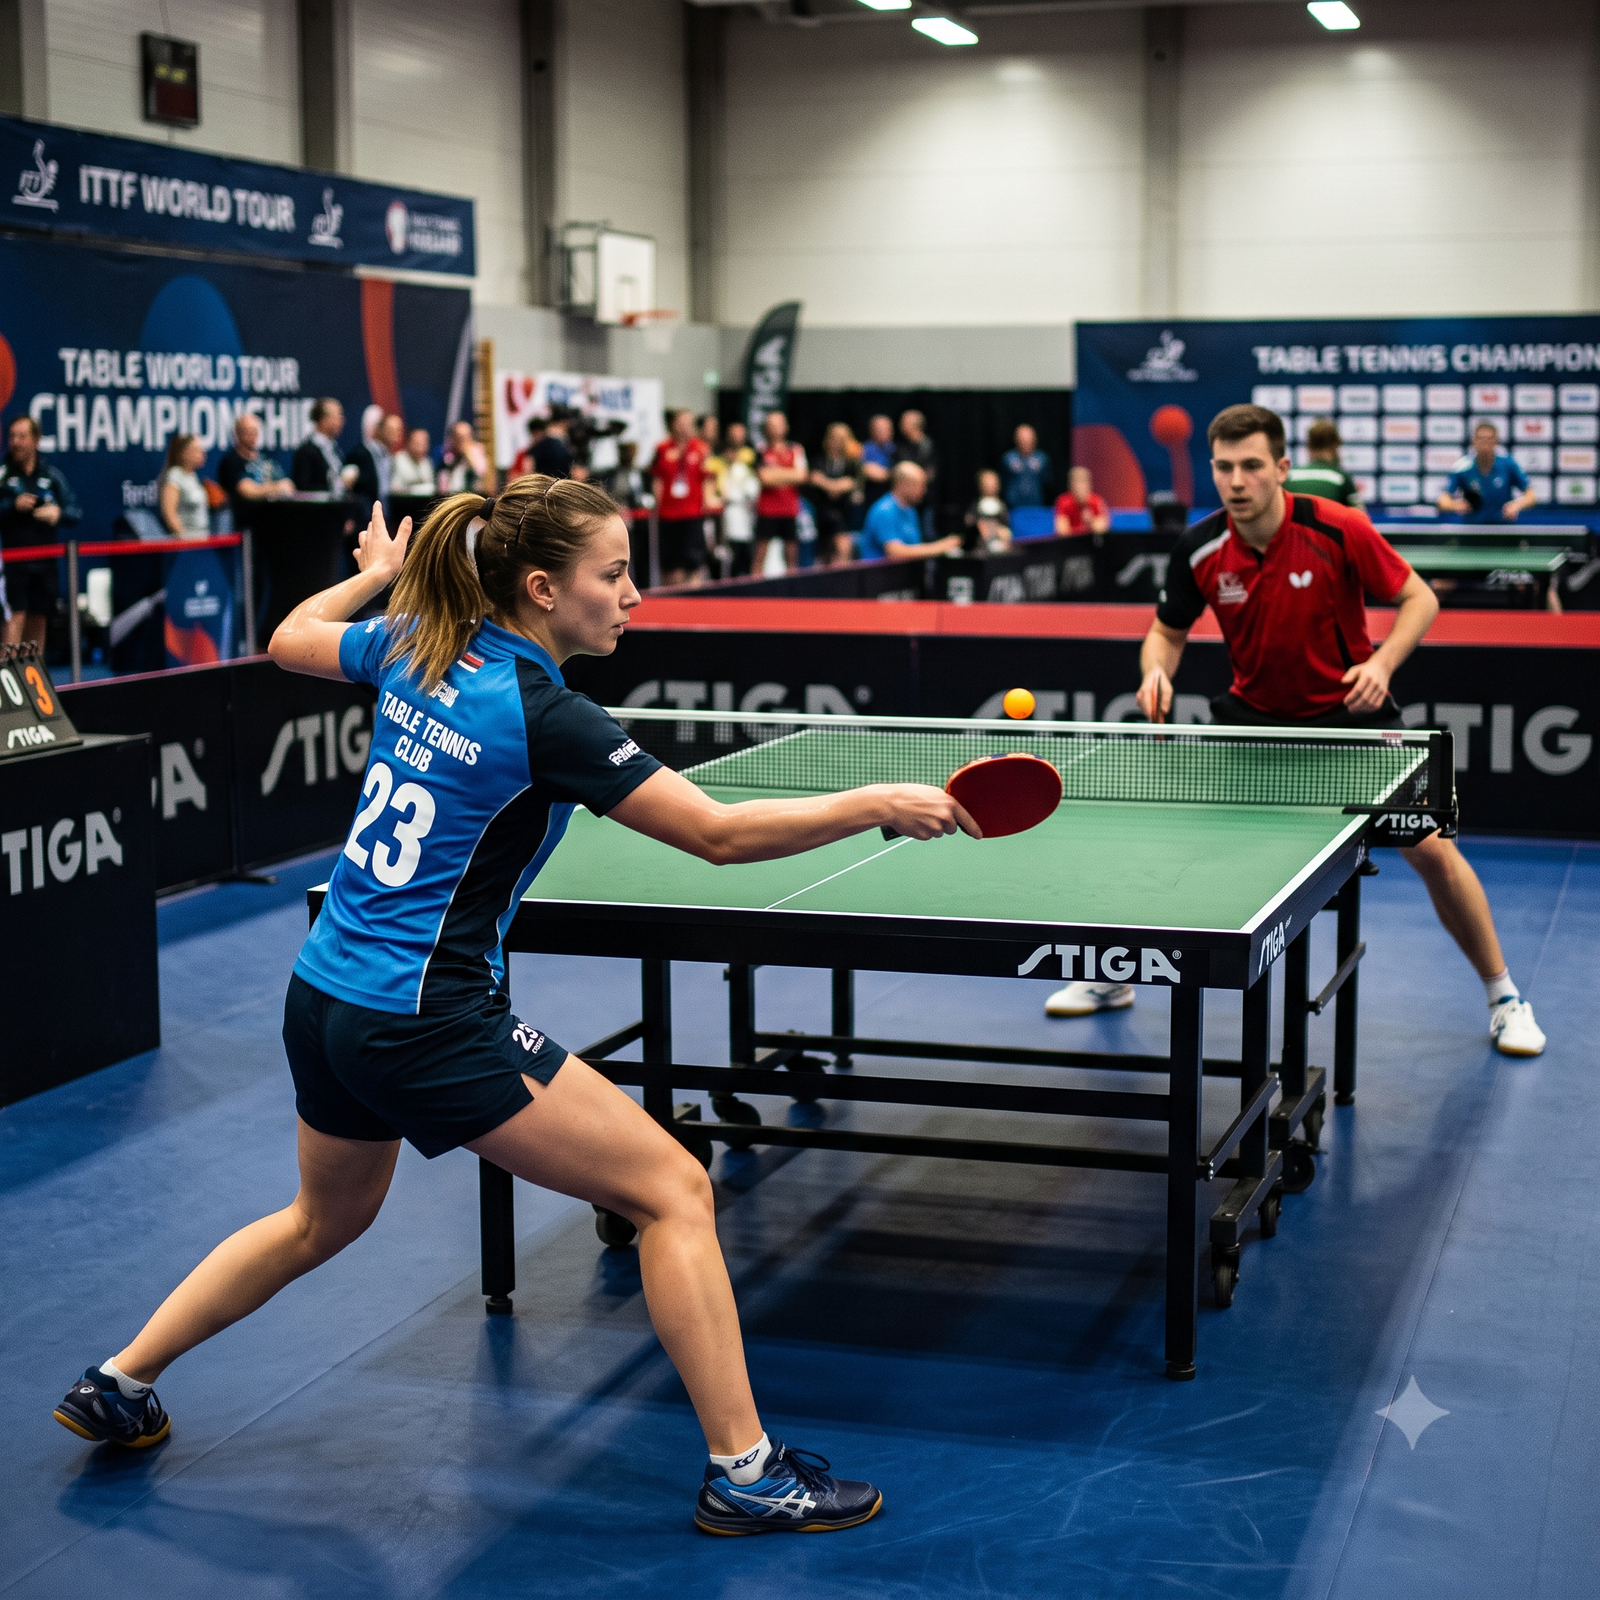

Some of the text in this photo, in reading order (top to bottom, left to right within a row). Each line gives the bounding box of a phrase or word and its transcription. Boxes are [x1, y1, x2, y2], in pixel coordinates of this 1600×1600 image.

[79, 165, 138, 209] ITTF
[140, 174, 232, 223] WORLD
[233, 188, 296, 233] TOUR
[58, 348, 300, 393] TABLE WORLD TOUR
[1252, 345, 1342, 373] TABLE
[1343, 344, 1448, 373] TENNIS
[25, 666, 54, 715] 3
[7, 725, 56, 749] STIGA
[261, 703, 377, 797] STIG
[381, 691, 424, 734] TABLE
[422, 717, 482, 765] TENNIS
[394, 735, 433, 772] CLUB
[344, 762, 436, 887] 23
[1375, 814, 1438, 829] STIGA
[1258, 921, 1285, 975] STIGA
